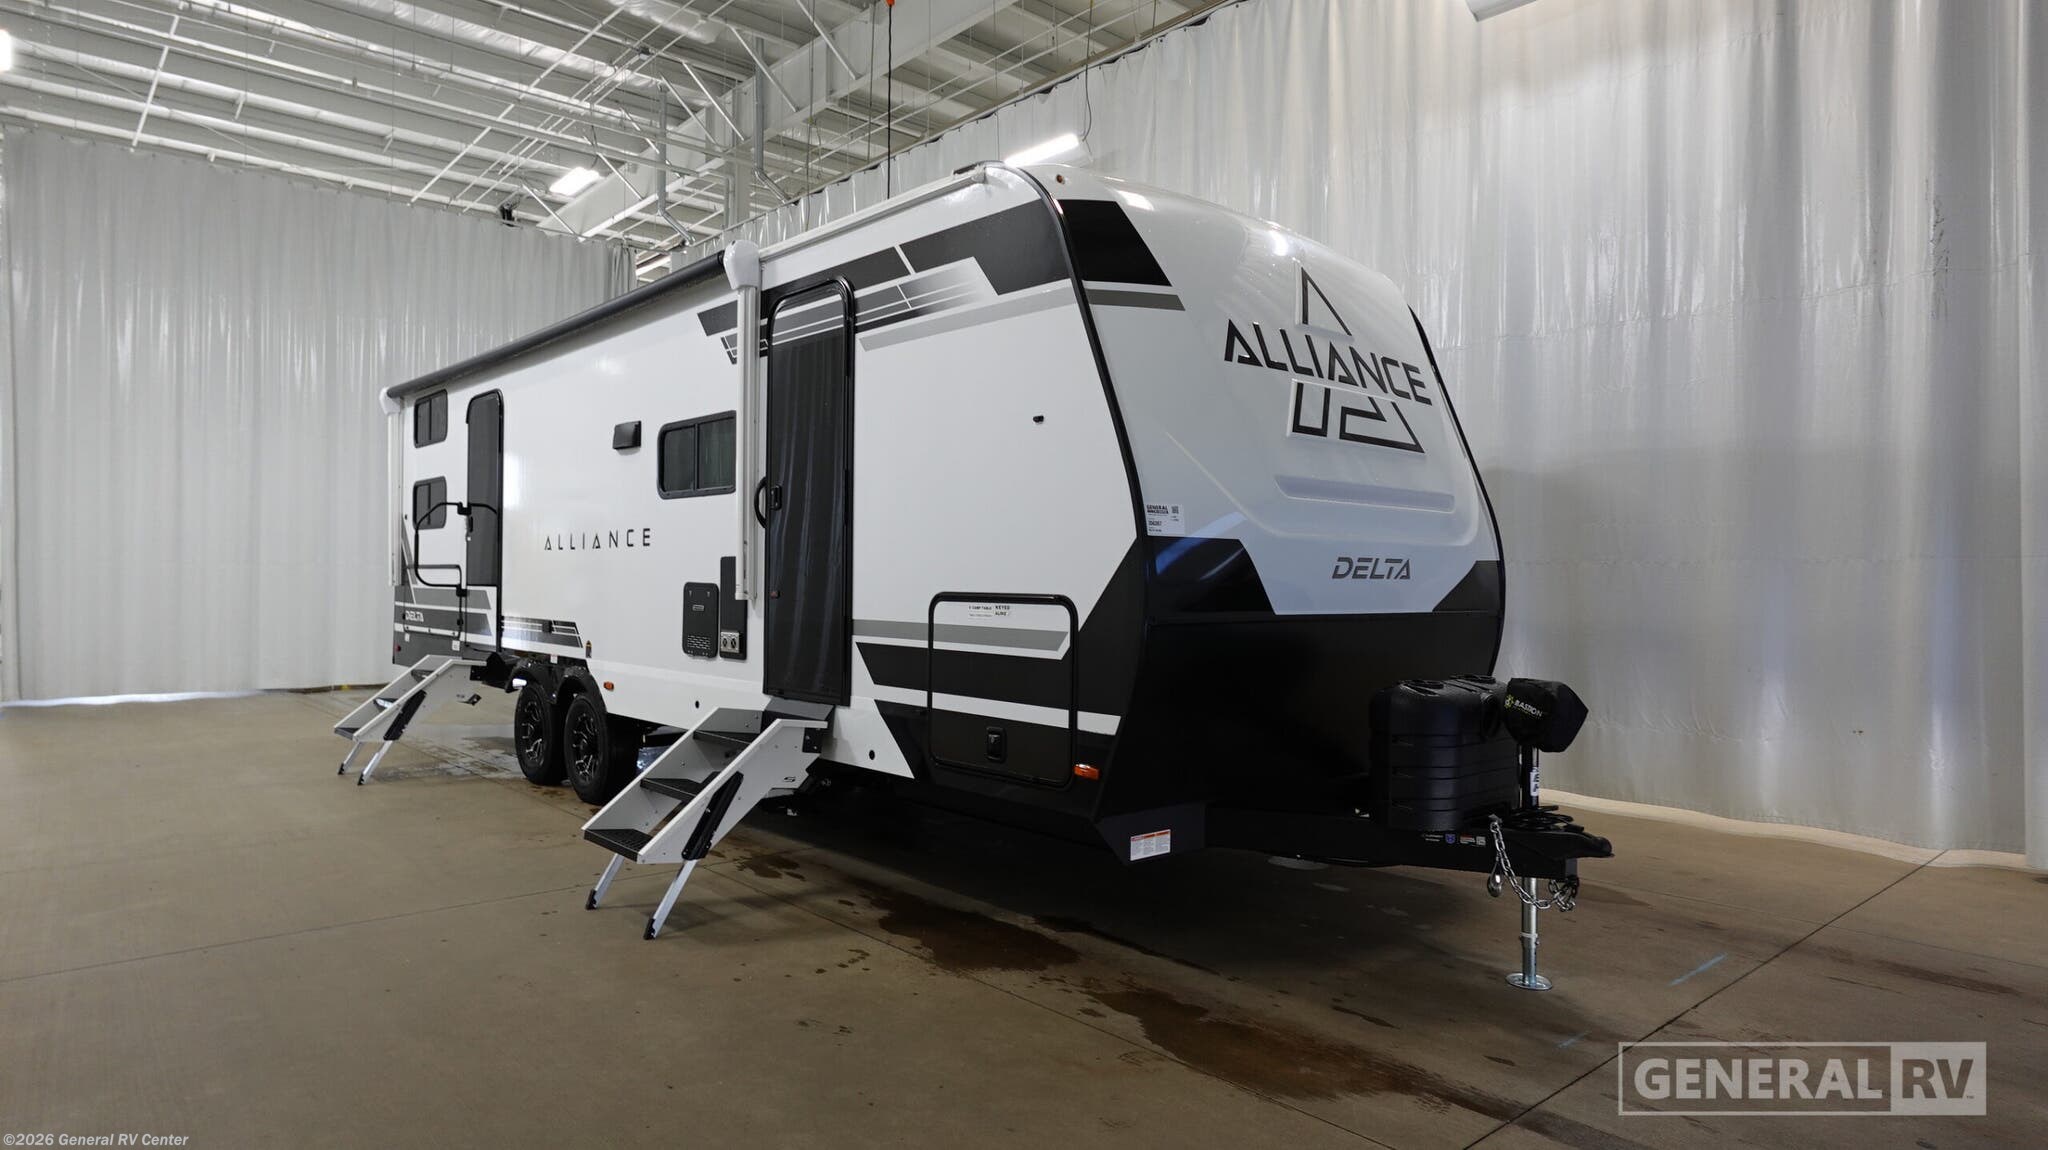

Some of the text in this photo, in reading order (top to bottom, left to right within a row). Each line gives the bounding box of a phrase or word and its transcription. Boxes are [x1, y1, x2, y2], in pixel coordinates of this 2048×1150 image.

[1224, 319, 1432, 406] ALLIANCE
[544, 528, 650, 550] ALLIANCE
[1332, 556, 1411, 580] DELTA
[405, 610, 424, 622] DELTA
[1514, 699, 1543, 717] BASTION
